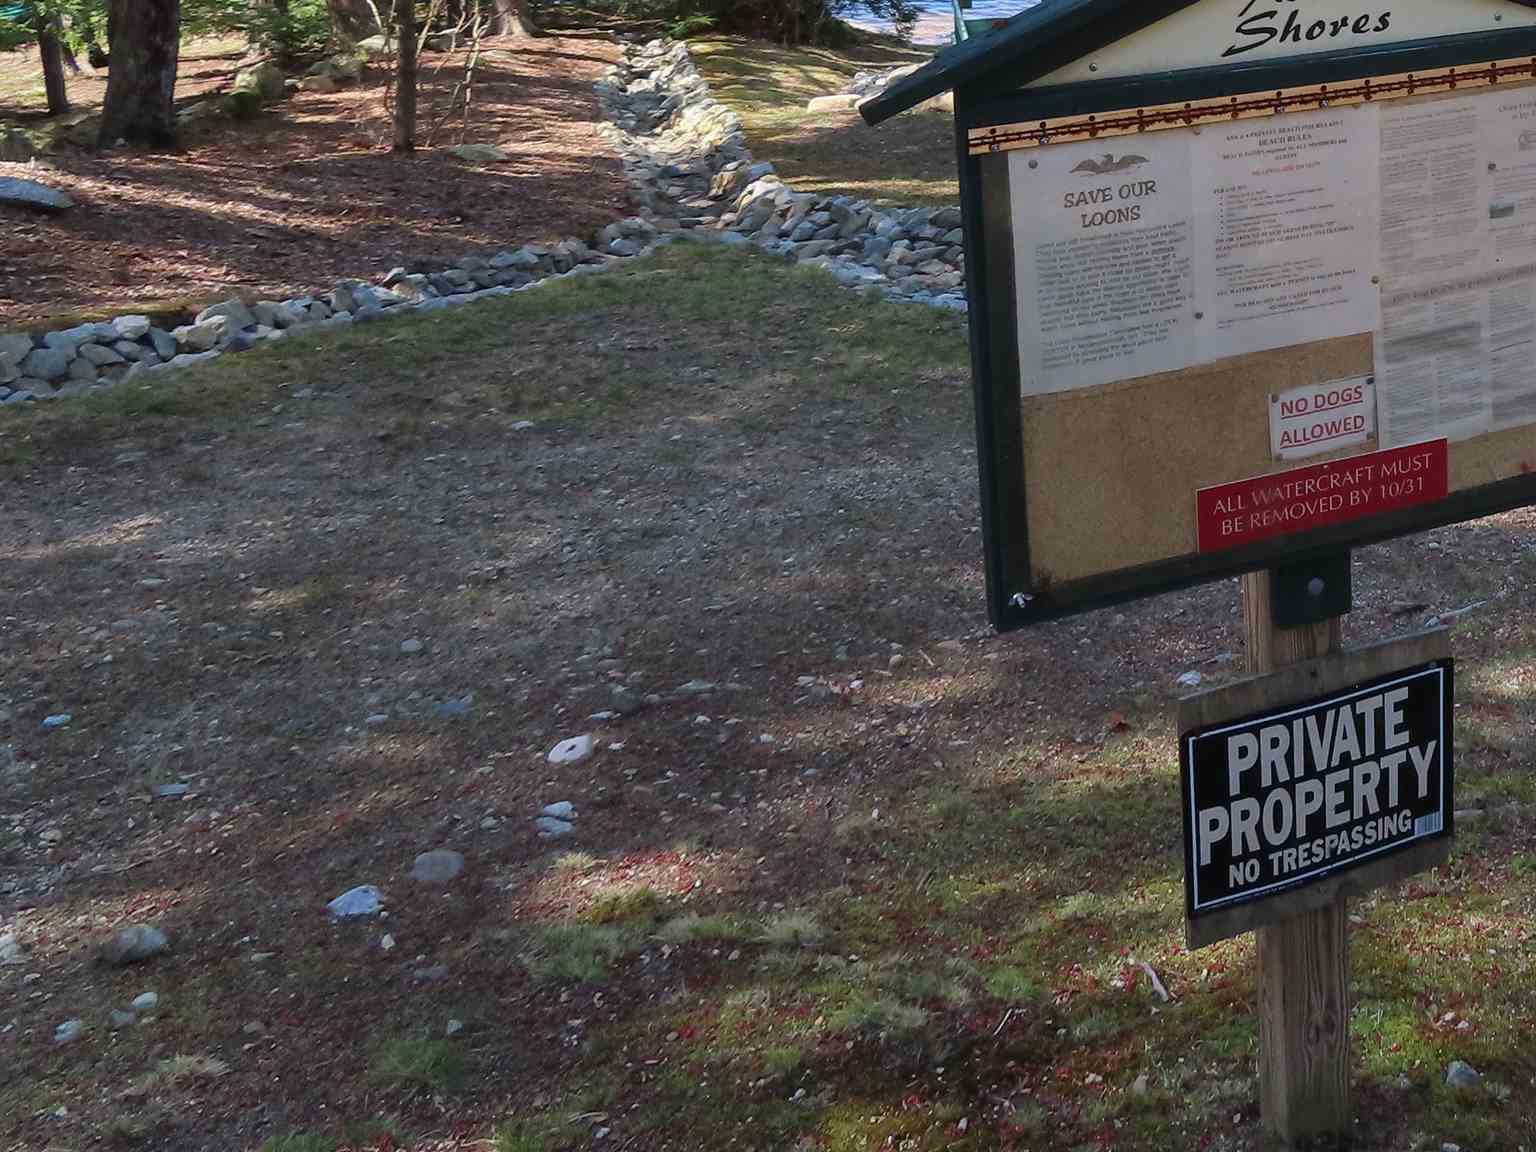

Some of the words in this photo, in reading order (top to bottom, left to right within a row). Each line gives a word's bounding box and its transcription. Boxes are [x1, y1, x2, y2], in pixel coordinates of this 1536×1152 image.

[1220, 9, 1392, 57] Shores
[1063, 187, 1113, 208] SAVE
[1118, 180, 1157, 199] OUR
[1081, 205, 1141, 228] LOONS
[1280, 398, 1308, 417] NO
[1313, 385, 1363, 408] DOGS
[1279, 414, 1365, 445] ALLOWED
[1213, 496, 1247, 516] ALL
[1252, 464, 1375, 505] WATERCRAFT
[1380, 452, 1433, 478] MUST
[1221, 517, 1244, 536] BE
[1250, 494, 1343, 530] REMOVED
[1350, 486, 1373, 506] BY
[1380, 475, 1424, 499] 10/31
[1227, 686, 1410, 797] PRIVATE
[1200, 739, 1437, 866] PROPERTY
[1228, 858, 1260, 889] NO
[1268, 809, 1412, 877] TRESPASSING
